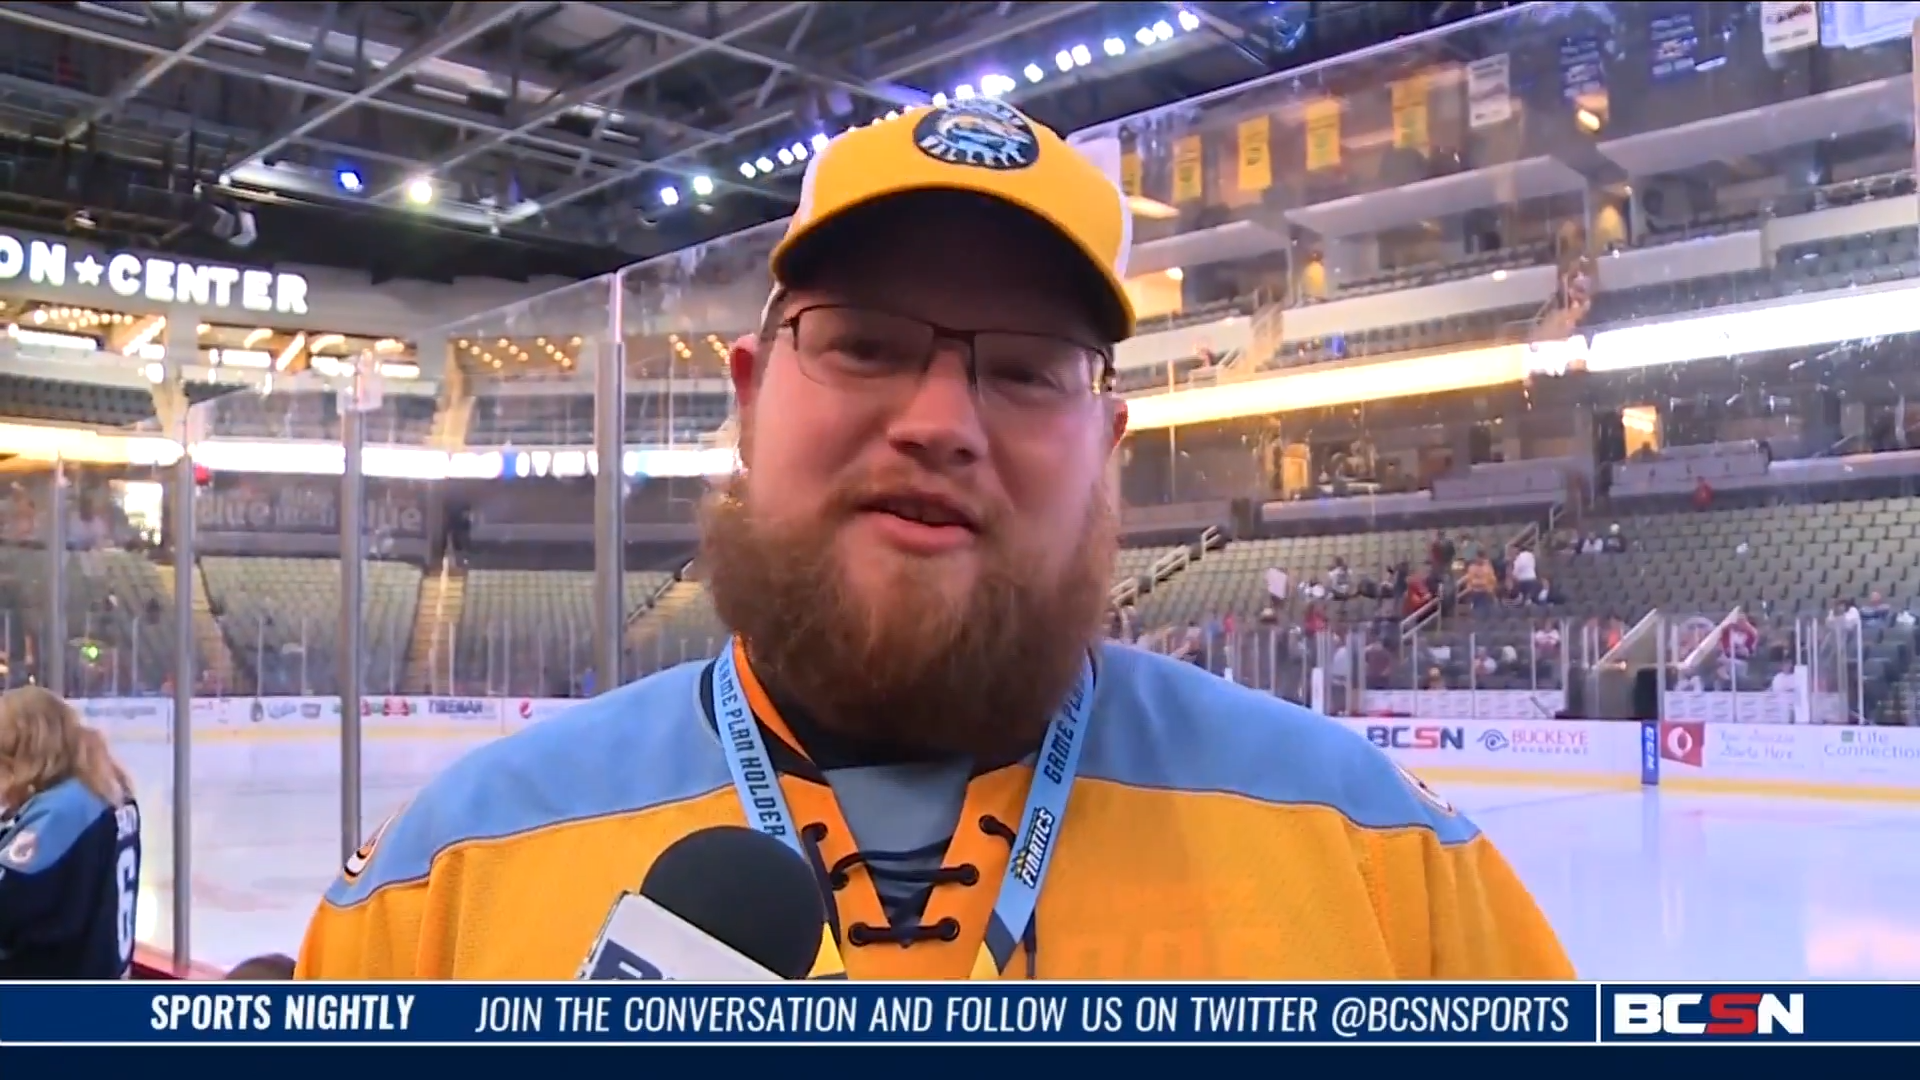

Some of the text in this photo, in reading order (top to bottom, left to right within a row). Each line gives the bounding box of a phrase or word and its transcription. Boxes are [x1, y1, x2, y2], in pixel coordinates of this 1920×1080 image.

[107, 253, 309, 315] CENTER
[725, 707, 756, 753] PLAN
[1043, 678, 1085, 785] GAME PLA
[1366, 725, 1588, 749] BCSN BUCKEYE
[1857, 730, 1889, 744] Life
[739, 755, 788, 839] HOLDER
